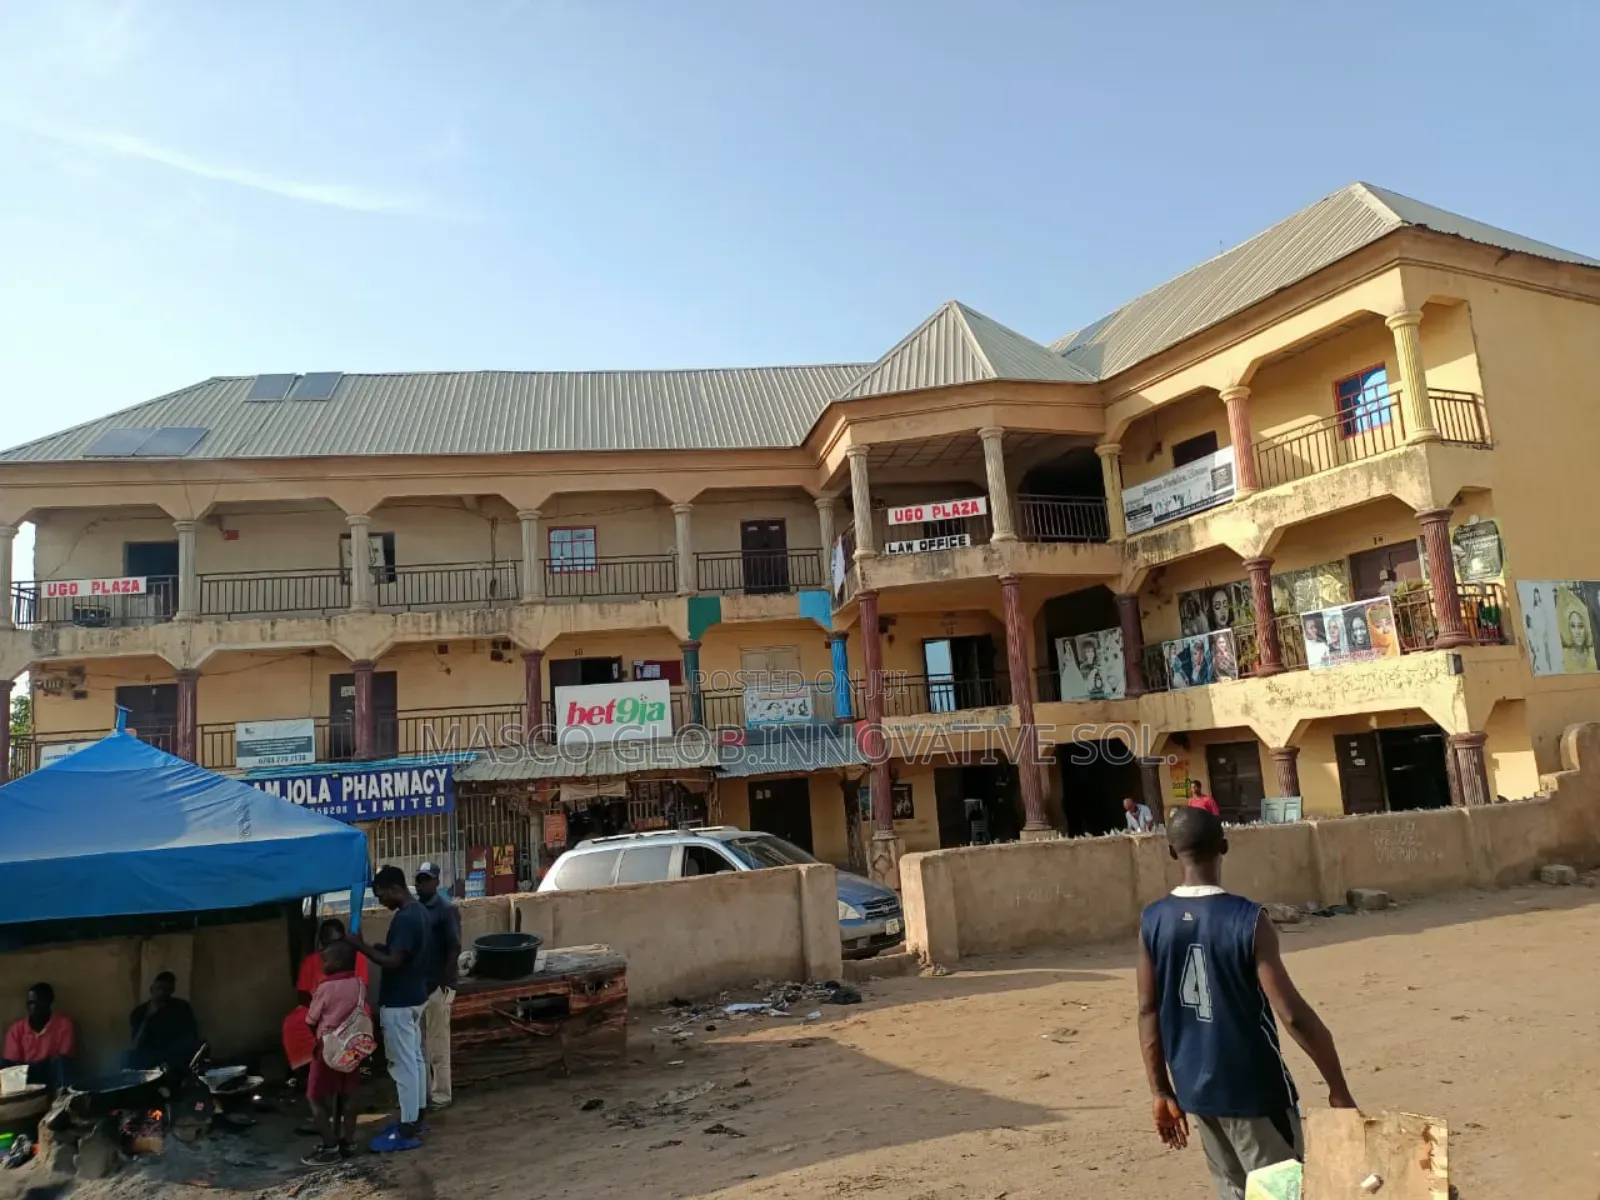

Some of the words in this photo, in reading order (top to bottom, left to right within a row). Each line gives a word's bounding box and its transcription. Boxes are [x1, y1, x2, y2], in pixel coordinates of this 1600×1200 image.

[894, 507, 923, 522] UGO
[931, 500, 979, 519] PLAZA
[888, 541, 914, 553] LAW
[920, 535, 966, 551] OFFICE
[47, 582, 78, 597] UGO
[91, 579, 140, 595] PLAZA
[566, 697, 666, 727] bet9ja
[342, 768, 447, 801] PHARMACY
[357, 796, 445, 814] LIMITED
[1179, 944, 1213, 1022] 4
